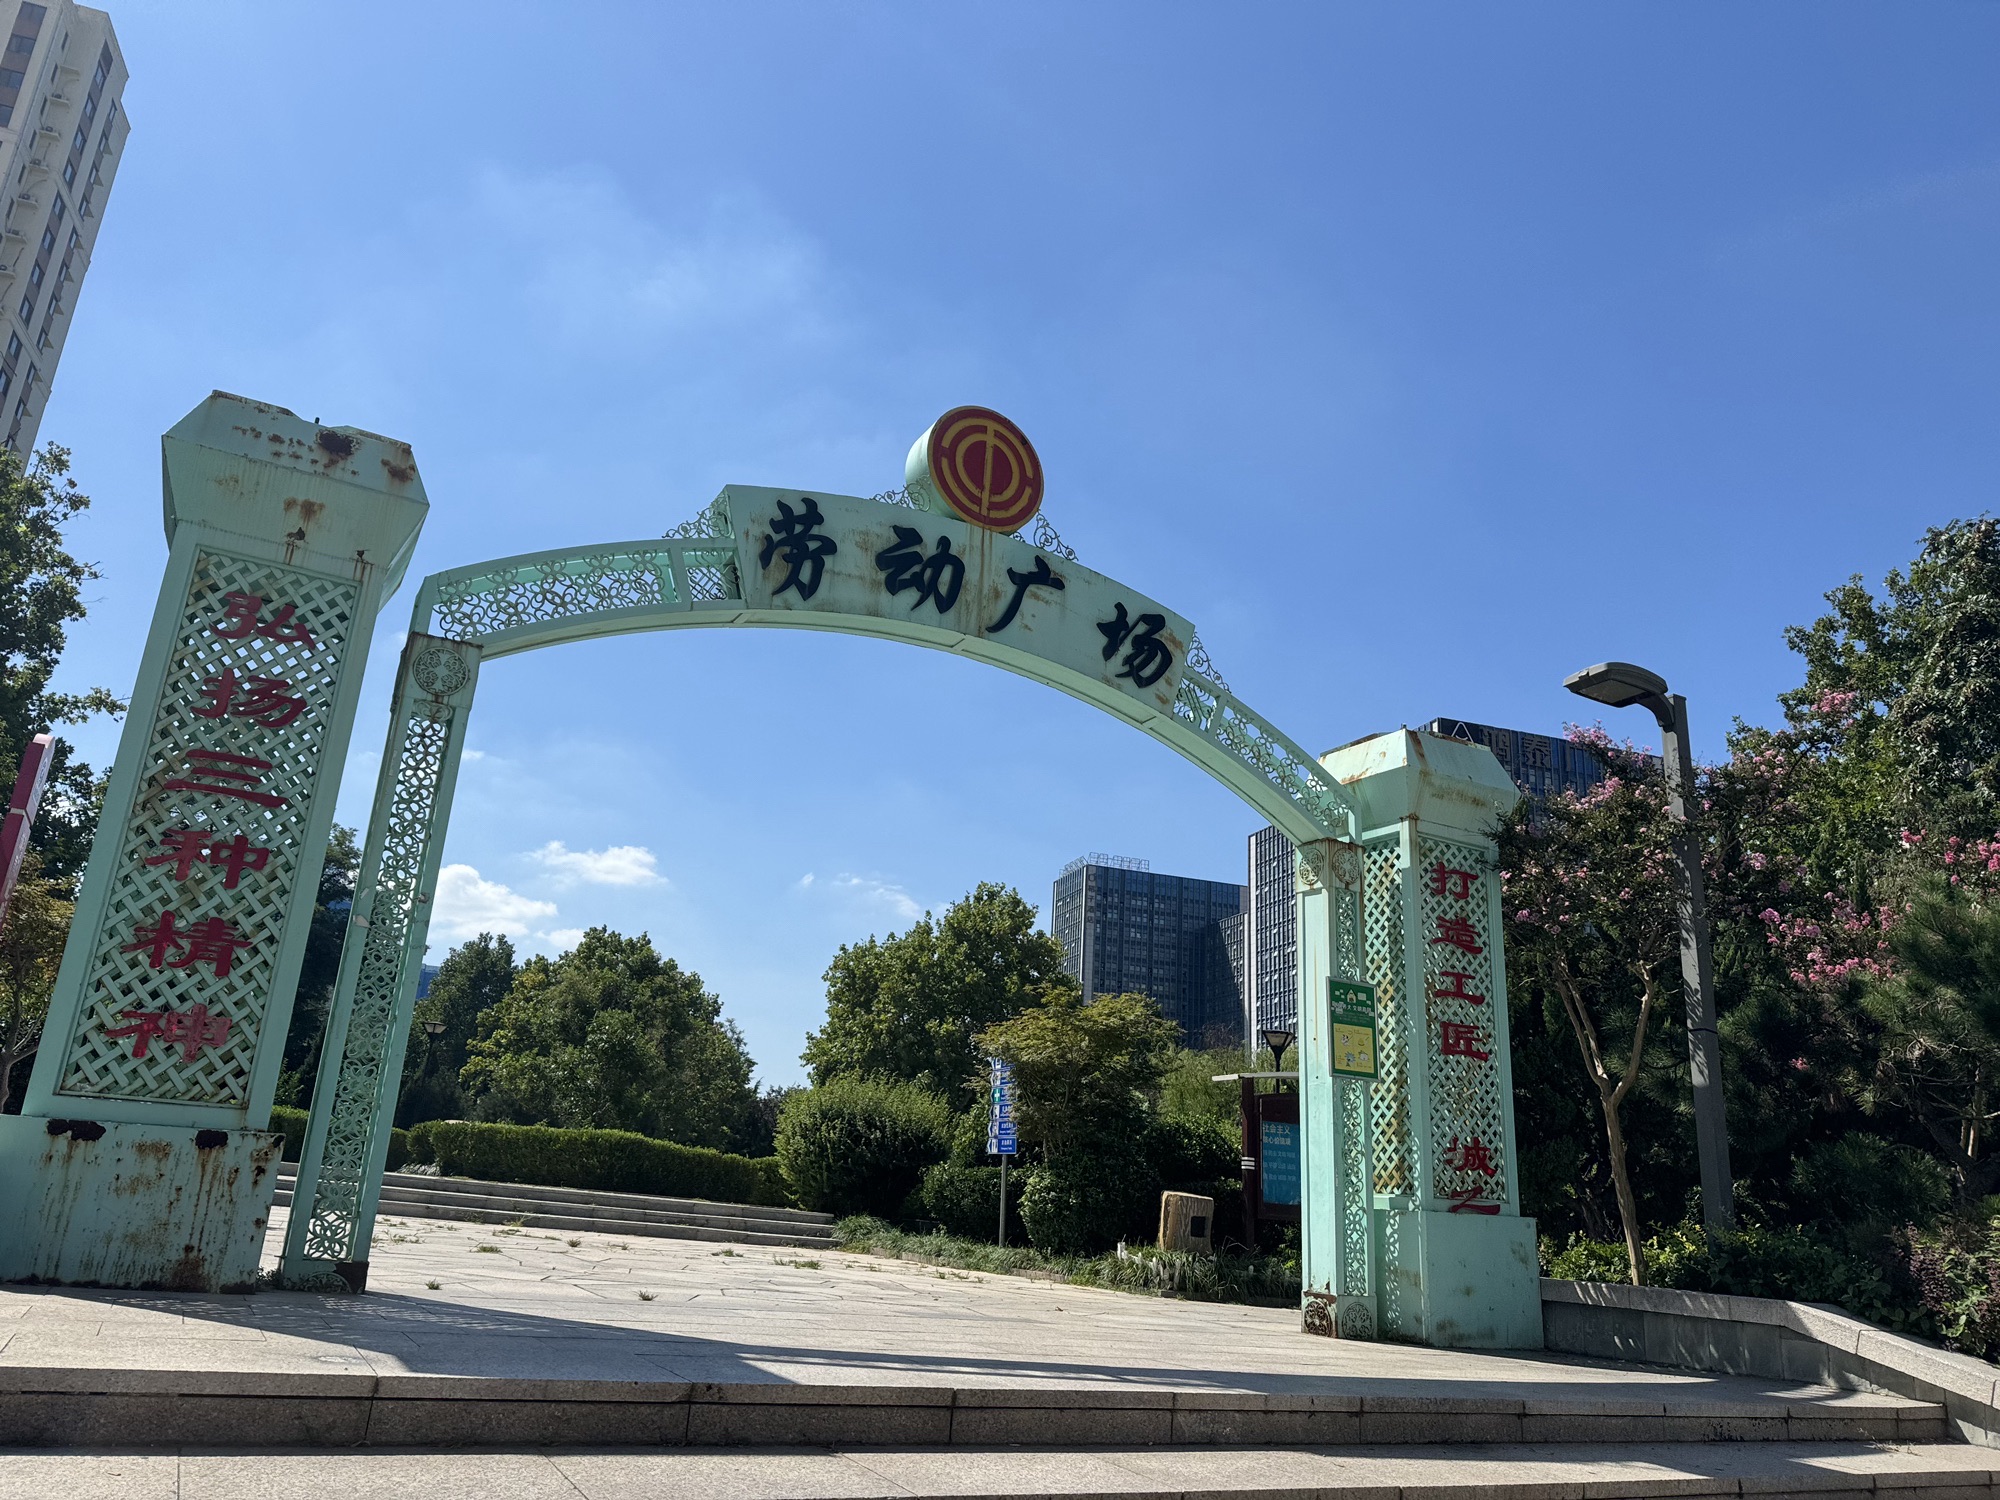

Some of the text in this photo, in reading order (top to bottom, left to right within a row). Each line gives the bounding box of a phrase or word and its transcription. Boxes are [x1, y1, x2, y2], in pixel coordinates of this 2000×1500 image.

[760, 497, 1173, 688] 劳动广场
[104, 591, 316, 1063] 弘扬三种精神
